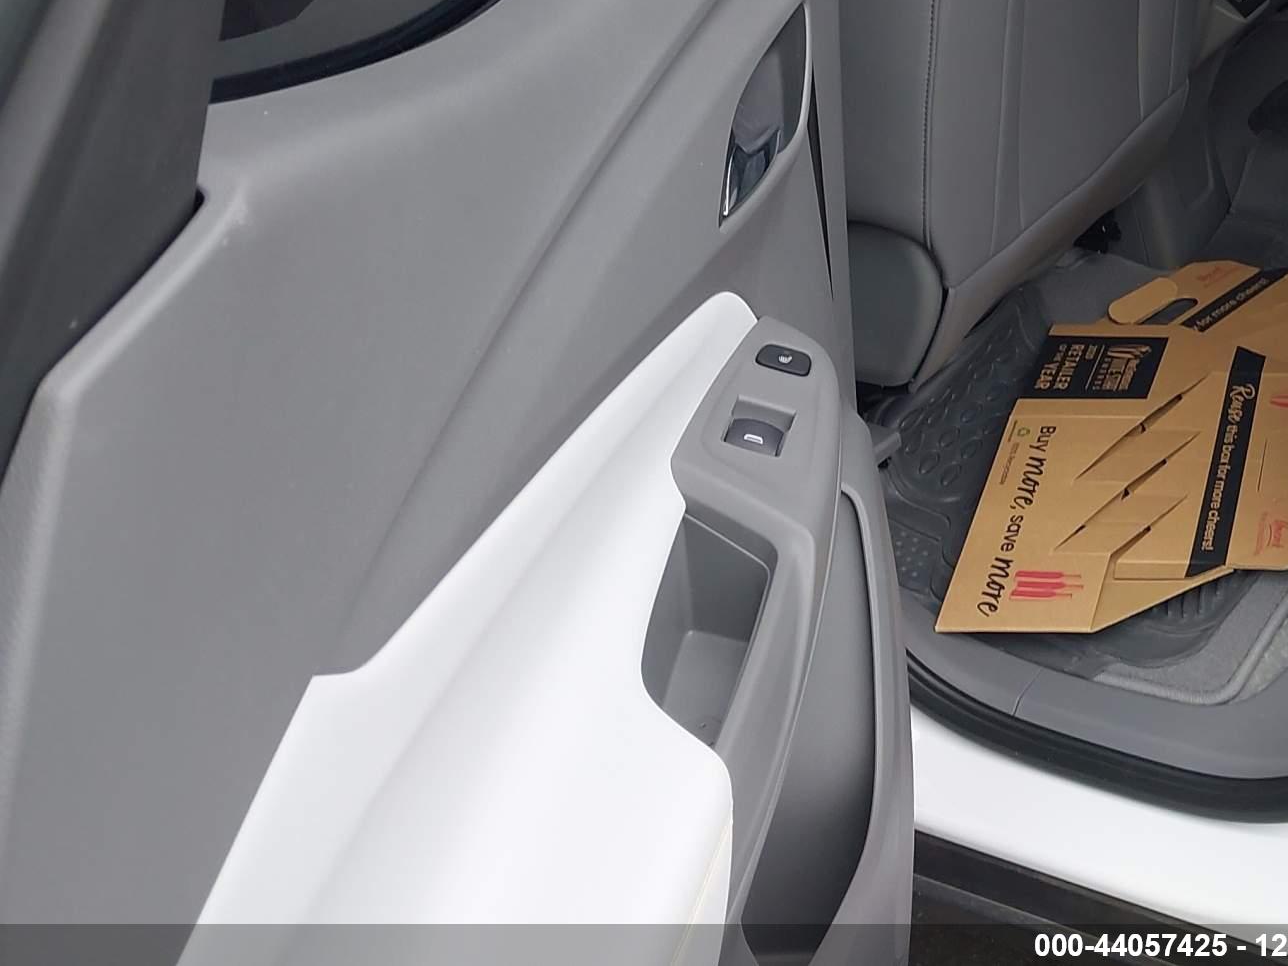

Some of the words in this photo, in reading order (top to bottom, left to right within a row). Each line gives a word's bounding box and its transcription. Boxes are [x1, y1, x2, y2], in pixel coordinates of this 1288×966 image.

[1034, 362, 1058, 390] YEAR
[1053, 344, 1085, 390] RETAILER
[1228, 383, 1256, 424] Reuse
[1029, 426, 1057, 452] Buy
[1224, 424, 1239, 444] this
[1219, 444, 1236, 463] box
[1009, 456, 1047, 510] more,
[1216, 463, 1231, 480] for
[1210, 480, 1225, 510] more
[1000, 514, 1024, 552] save
[1201, 509, 1221, 551] cheers!
[977, 556, 1014, 617] more
